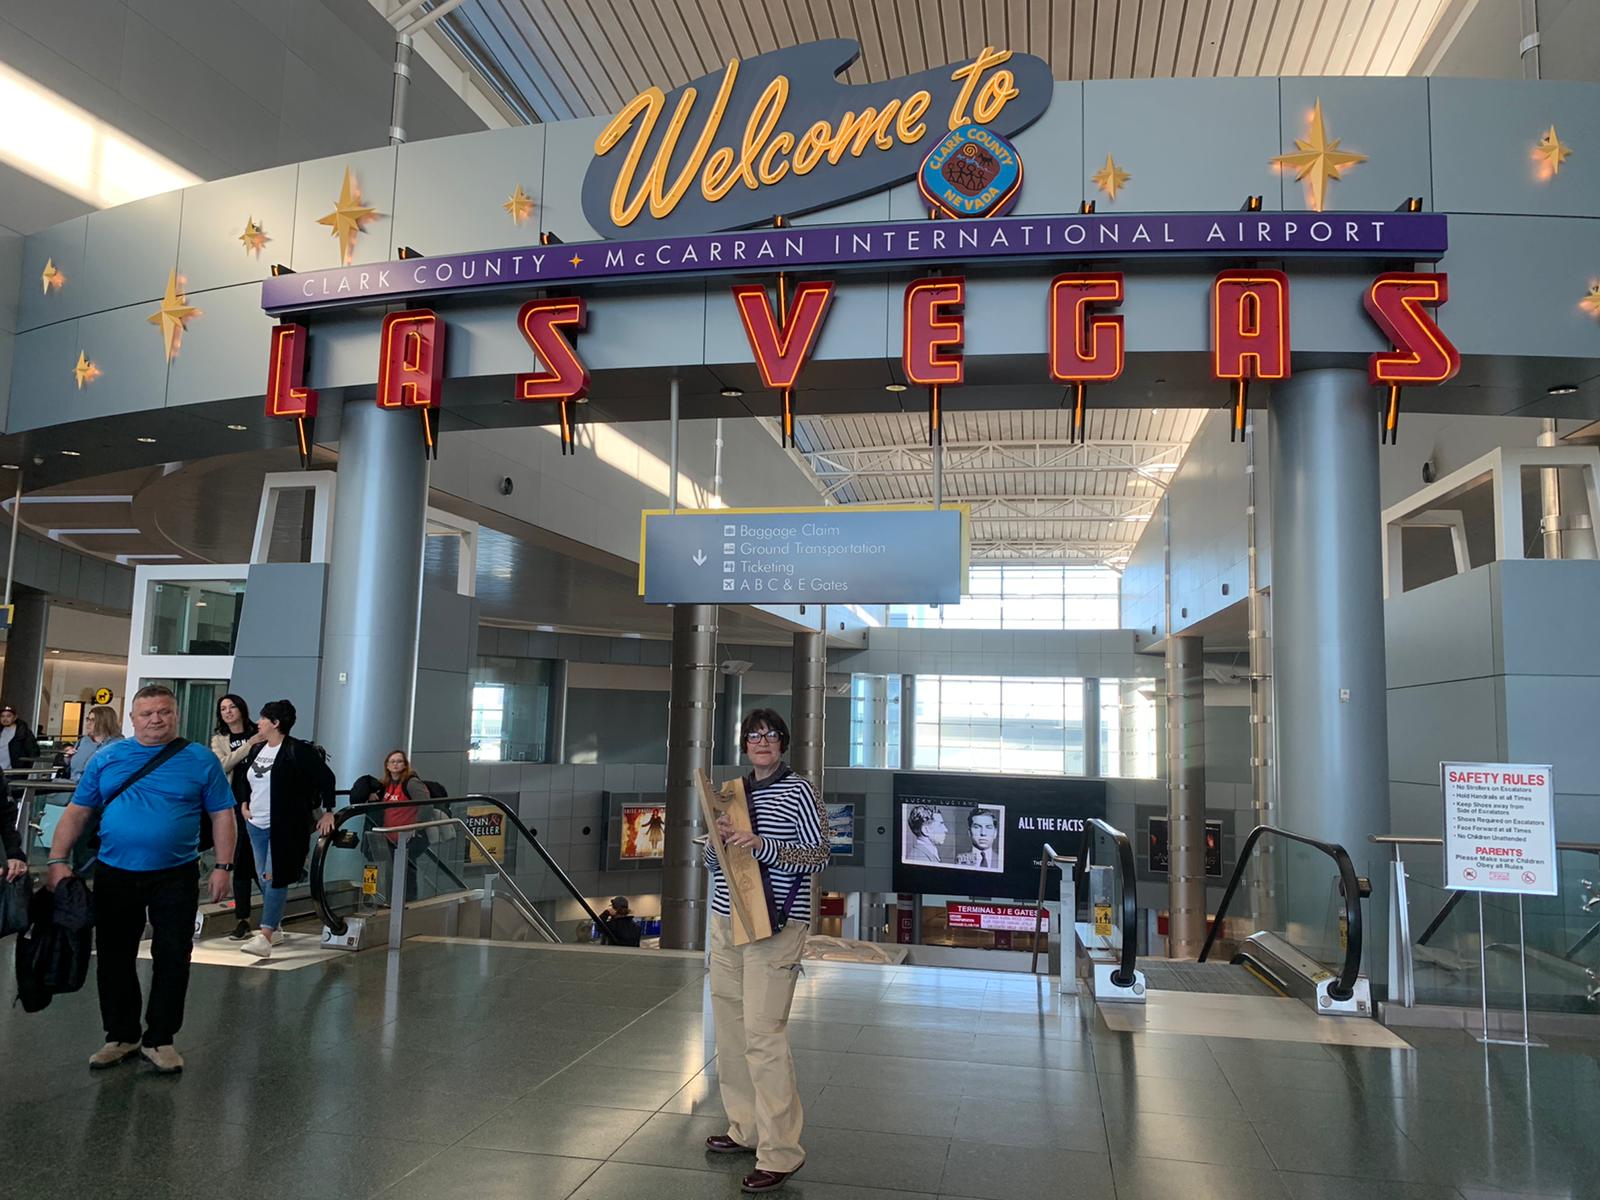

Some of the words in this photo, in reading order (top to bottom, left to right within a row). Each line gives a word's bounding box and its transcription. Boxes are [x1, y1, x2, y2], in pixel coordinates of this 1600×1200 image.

[594, 57, 931, 227] Welcome
[948, 46, 1019, 131] to
[930, 132, 965, 169] CLARK
[967, 128, 1013, 165] COUNTY
[944, 187, 999, 210] NEVADA
[302, 269, 391, 298] CLARK
[413, 253, 546, 285] COUNTY
[605, 236, 804, 269] McCARRAN
[835, 222, 1175, 254] INTERNATIONAL
[1206, 220, 1386, 244] AIRPORT
[265, 296, 591, 418] LAS
[731, 268, 1461, 389] VEGAS
[740, 524, 797, 540] Baggage
[801, 523, 840, 537] Claim
[740, 542, 789, 555] Ground
[794, 541, 886, 556] Transportation
[740, 560, 794, 575] Ticketing
[740, 579, 750, 591] A
[755, 579, 763, 591] B
[767, 578, 778, 591] C
[783, 578, 792, 591] &
[798, 578, 806, 591] E
[811, 577, 848, 591] Gates
[1449, 771, 1499, 784] SAFETY
[1502, 773, 1545, 786] RULES
[471, 826, 500, 835] TELLER
[1018, 817, 1035, 829] ALL
[1036, 818, 1055, 830] THE
[1056, 818, 1084, 832] FACTS
[1475, 846, 1523, 856] PARENTS
[957, 905, 995, 914] TERMINAL
